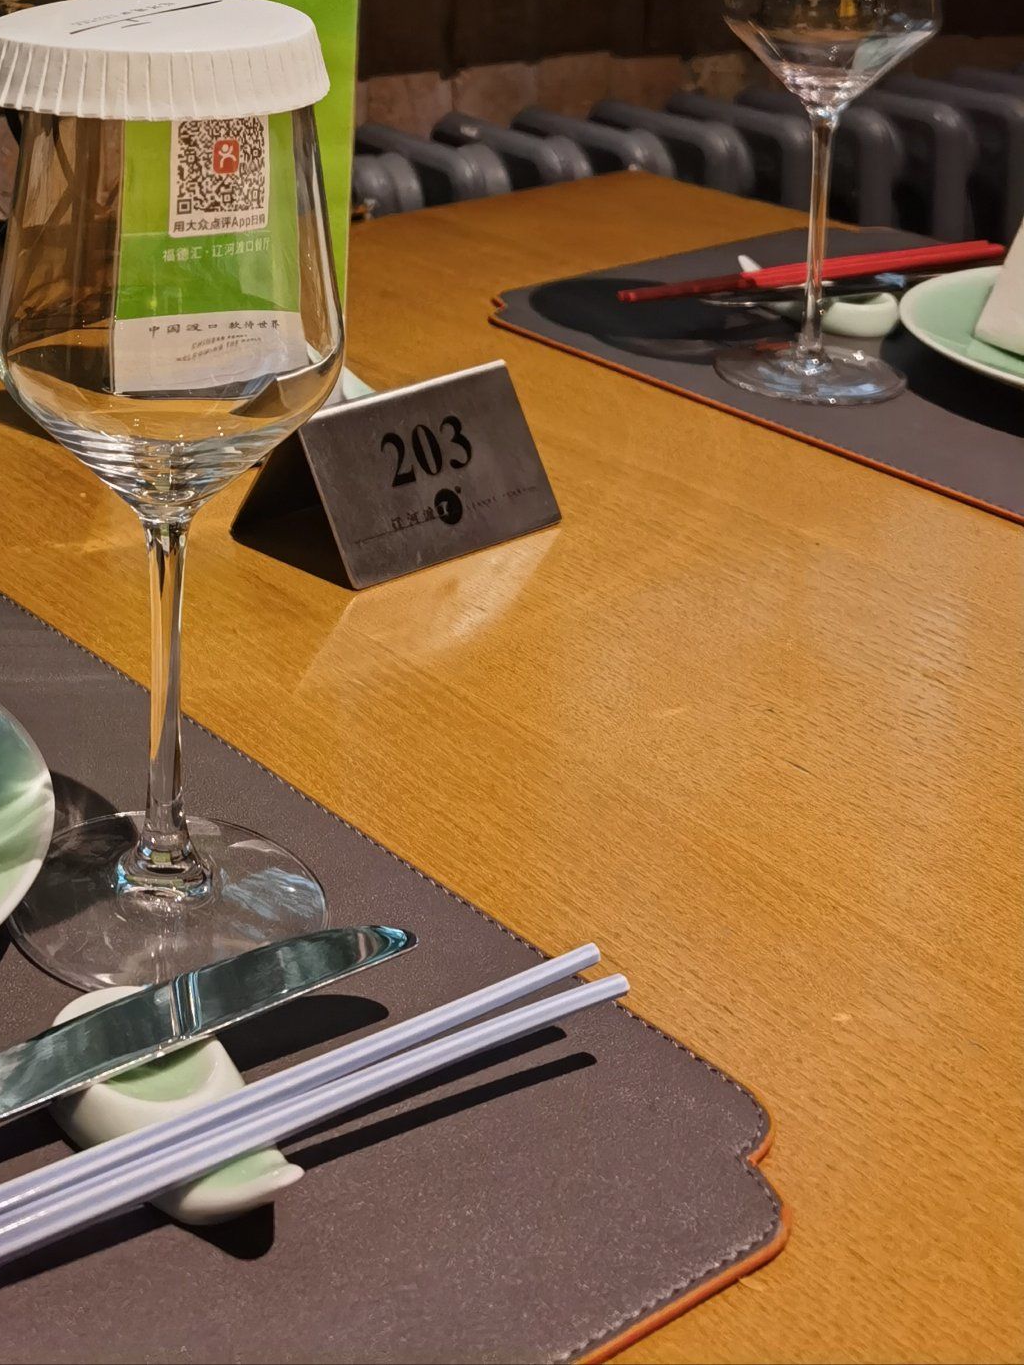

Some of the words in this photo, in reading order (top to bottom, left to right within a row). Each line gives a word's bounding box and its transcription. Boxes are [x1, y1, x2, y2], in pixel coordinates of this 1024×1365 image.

[149, 322, 218, 339] 中国渡口
[380, 415, 473, 487] 203
